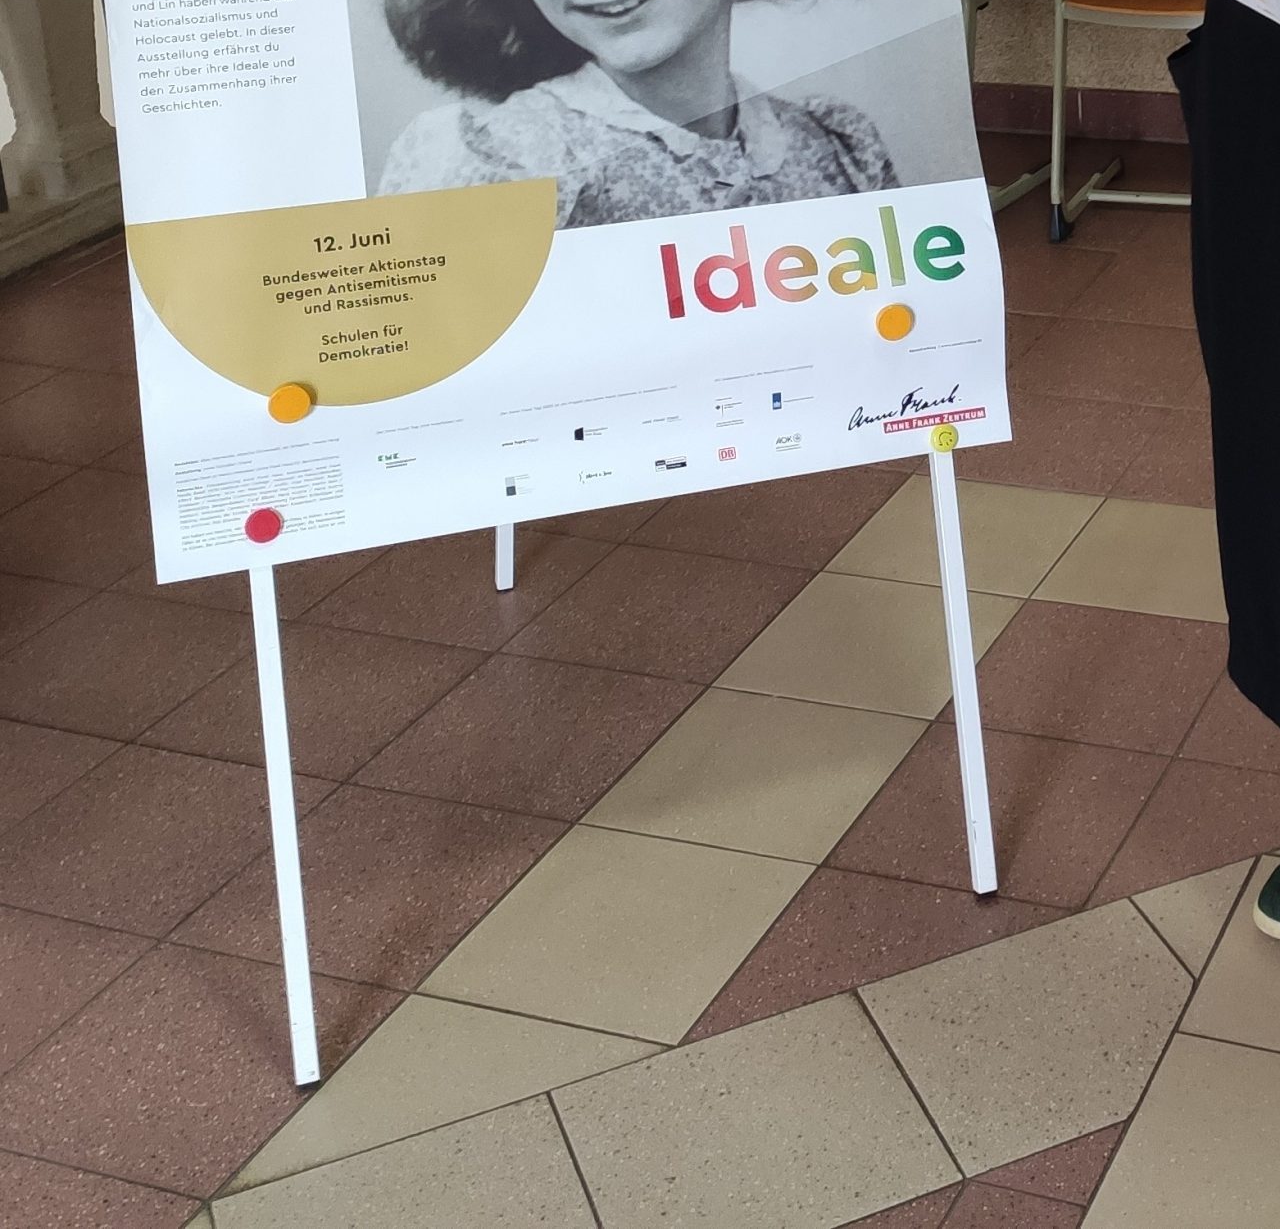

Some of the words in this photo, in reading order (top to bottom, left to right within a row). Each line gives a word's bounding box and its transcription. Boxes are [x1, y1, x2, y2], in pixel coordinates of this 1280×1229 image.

[131, 0, 154, 11] und
[158, 0, 175, 9] Lin
[133, 9, 252, 28] Nationalsozialismus
[255, 8, 278, 19] und
[135, 34, 196, 45] Holocaust
[199, 29, 242, 42] gelebt.
[259, 26, 295, 35] dieser
[136, 50, 209, 62] Ausstellung
[213, 45, 260, 56] erfährst
[263, 42, 279, 52] du
[138, 69, 170, 79] mehr
[174, 66, 202, 76] über
[206, 64, 229, 73] ihre
[232, 60, 269, 71] Ideale
[272, 57, 295, 67] und
[140, 87, 164, 96] den
[168, 75, 266, 94] Zusammenhang
[269, 75, 297, 84] ihrer
[141, 100, 222, 113] Geschichten.
[313, 236, 343, 253] 12.
[349, 227, 391, 249] Juni
[262, 264, 364, 286] Bundesweiter
[368, 255, 446, 272] Aktionstag
[660, 205, 965, 319] Ideale
[276, 285, 322, 303] gegen
[327, 272, 437, 295] Antisemitismus
[304, 300, 332, 315] und
[336, 293, 414, 310] Rassismus.
[321, 329, 379, 346] Schulen
[382, 324, 403, 337] für
[319, 340, 409, 363] Demokratie!
[886, 421, 910, 432] ANNE
[912, 417, 940, 428] FRANK
[942, 410, 985, 424] ZENTRUM
[720, 448, 735, 460] DB
